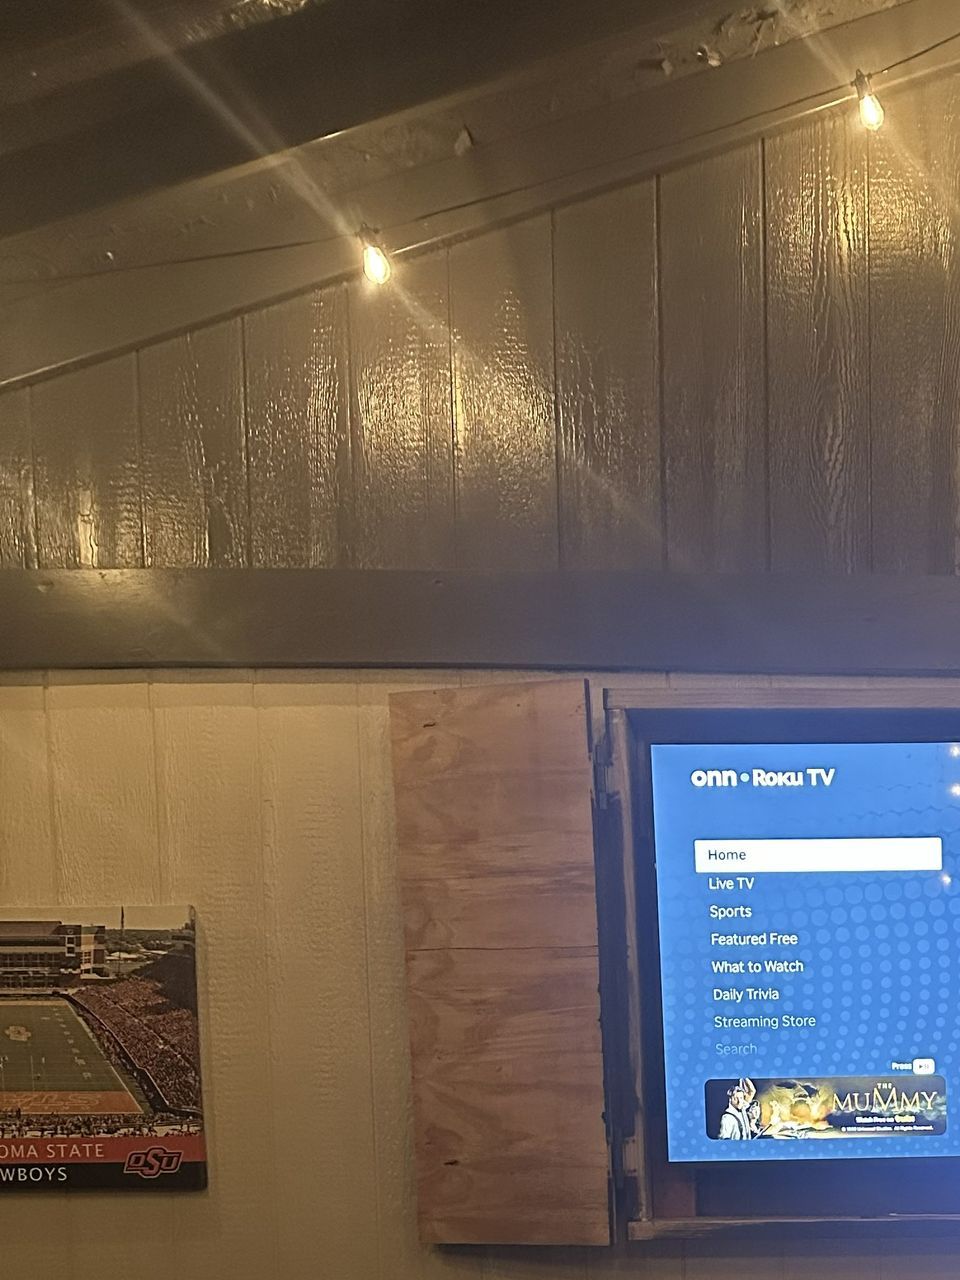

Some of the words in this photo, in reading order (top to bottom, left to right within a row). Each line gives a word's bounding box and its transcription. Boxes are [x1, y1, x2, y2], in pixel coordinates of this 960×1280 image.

[691, 769, 738, 787] onn
[752, 768, 804, 787] Roku
[806, 768, 836, 787] TV
[708, 849, 747, 861] Home
[708, 877, 735, 890] Live
[736, 877, 755, 890] TV
[709, 905, 753, 920] Sports
[711, 933, 767, 946] Featured
[769, 933, 798, 945] Free
[711, 961, 745, 974] What
[747, 962, 762, 973] to
[764, 960, 804, 973] Watch
[713, 988, 744, 1003] Daily
[746, 988, 780, 1001] Trivia
[714, 1015, 779, 1030] Streaming
[781, 1015, 817, 1027] Store
[715, 1043, 758, 1056] Search
[832, 1087, 938, 1113] MUMMY
[46, 1143, 105, 1158] STATE
[123, 1145, 184, 1179] OSU
[0, 1166, 68, 1182] WBOYS
